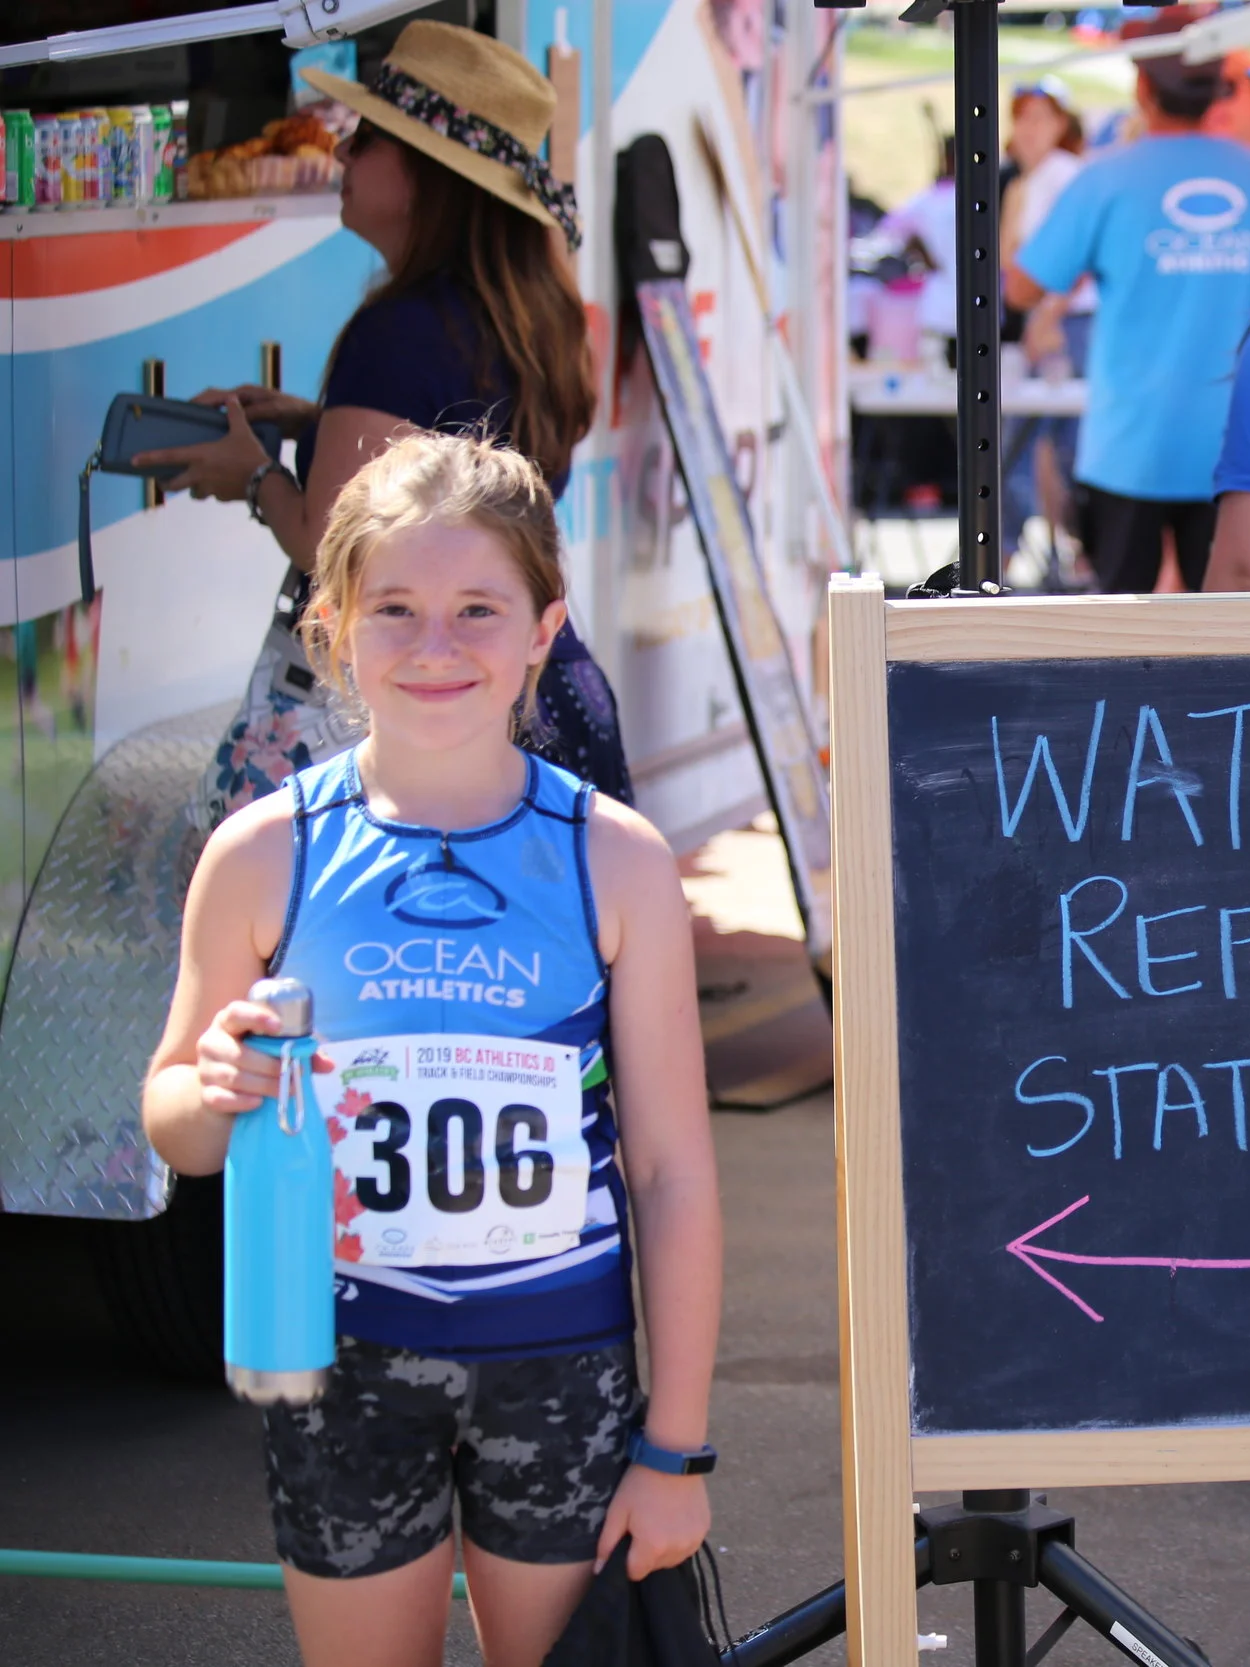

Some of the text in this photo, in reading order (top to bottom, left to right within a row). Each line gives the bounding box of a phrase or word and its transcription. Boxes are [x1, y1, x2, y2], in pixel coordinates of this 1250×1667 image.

[344, 938, 541, 987] OCEAN
[358, 979, 527, 1008] ATHLETICS
[417, 1046, 452, 1064] 2019
[455, 1046, 473, 1064] BC
[475, 1048, 540, 1071] ATHLETICS
[417, 1066, 448, 1080] TRACK
[460, 1067, 486, 1082] FIELD
[487, 1069, 558, 1089] CHAMPIONSHIPS
[355, 1098, 554, 1213] 306
[1131, 1641, 1169, 1667] SPEAKE
